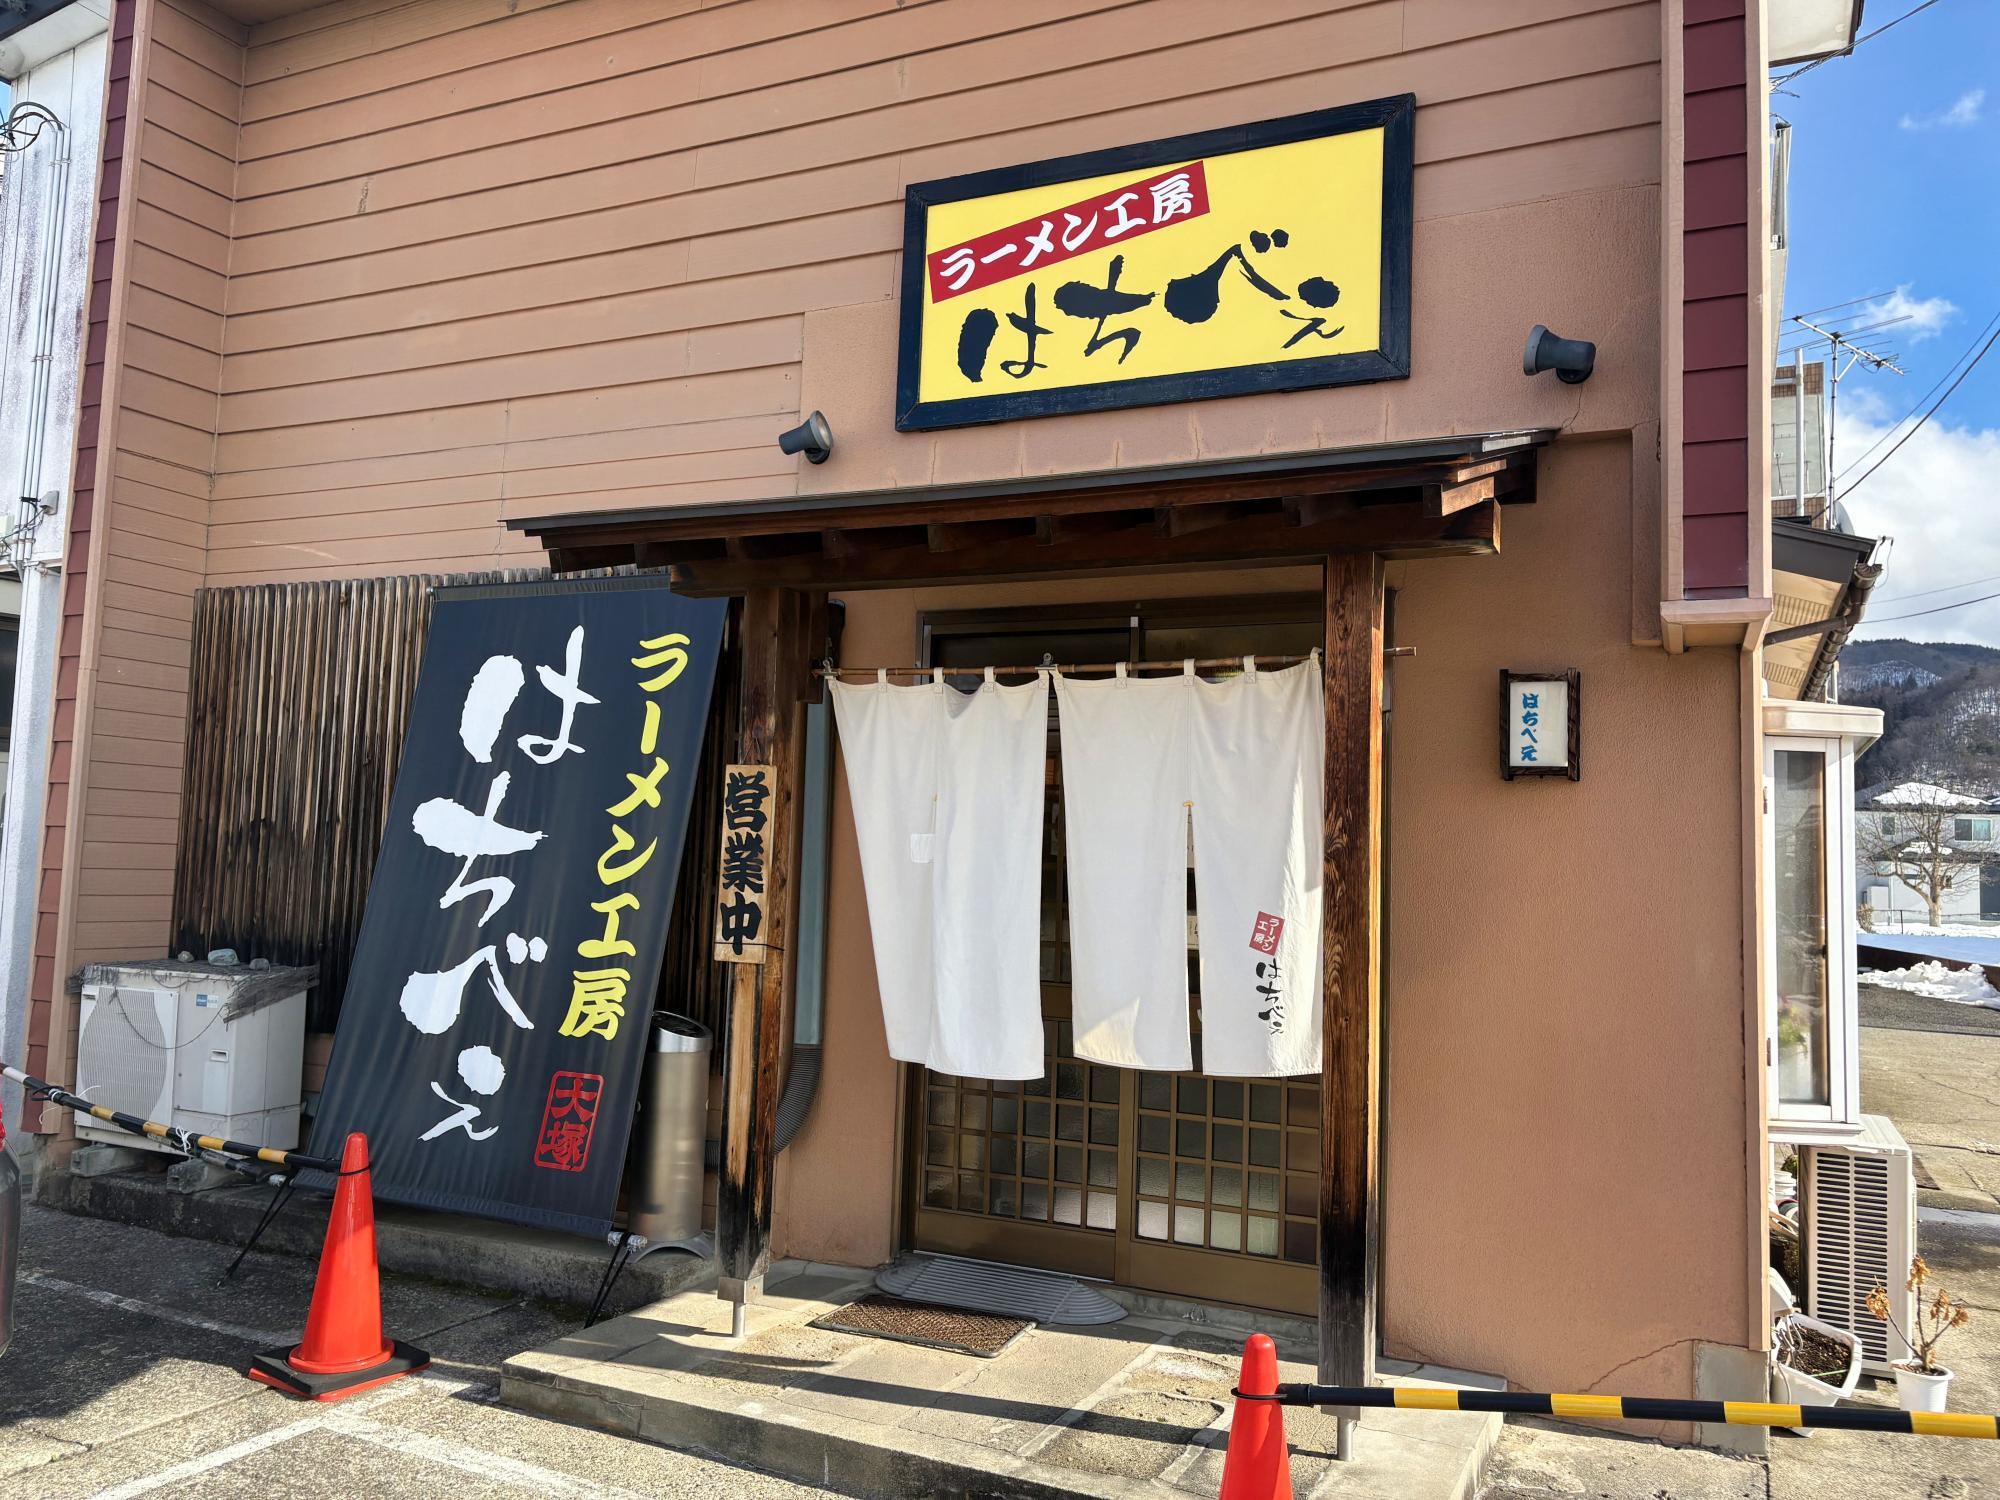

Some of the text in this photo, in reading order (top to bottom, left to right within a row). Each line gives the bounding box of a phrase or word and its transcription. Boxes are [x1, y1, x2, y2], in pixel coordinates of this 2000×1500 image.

[939, 172, 1194, 291] ラーメン工房
[1521, 693, 1539, 761] はちべえ
[558, 633, 690, 1041] ラーメン工房
[720, 771, 770, 955] 営業中
[1262, 918, 1280, 951] ラーメン
[540, 1079, 598, 1165] 大塚
